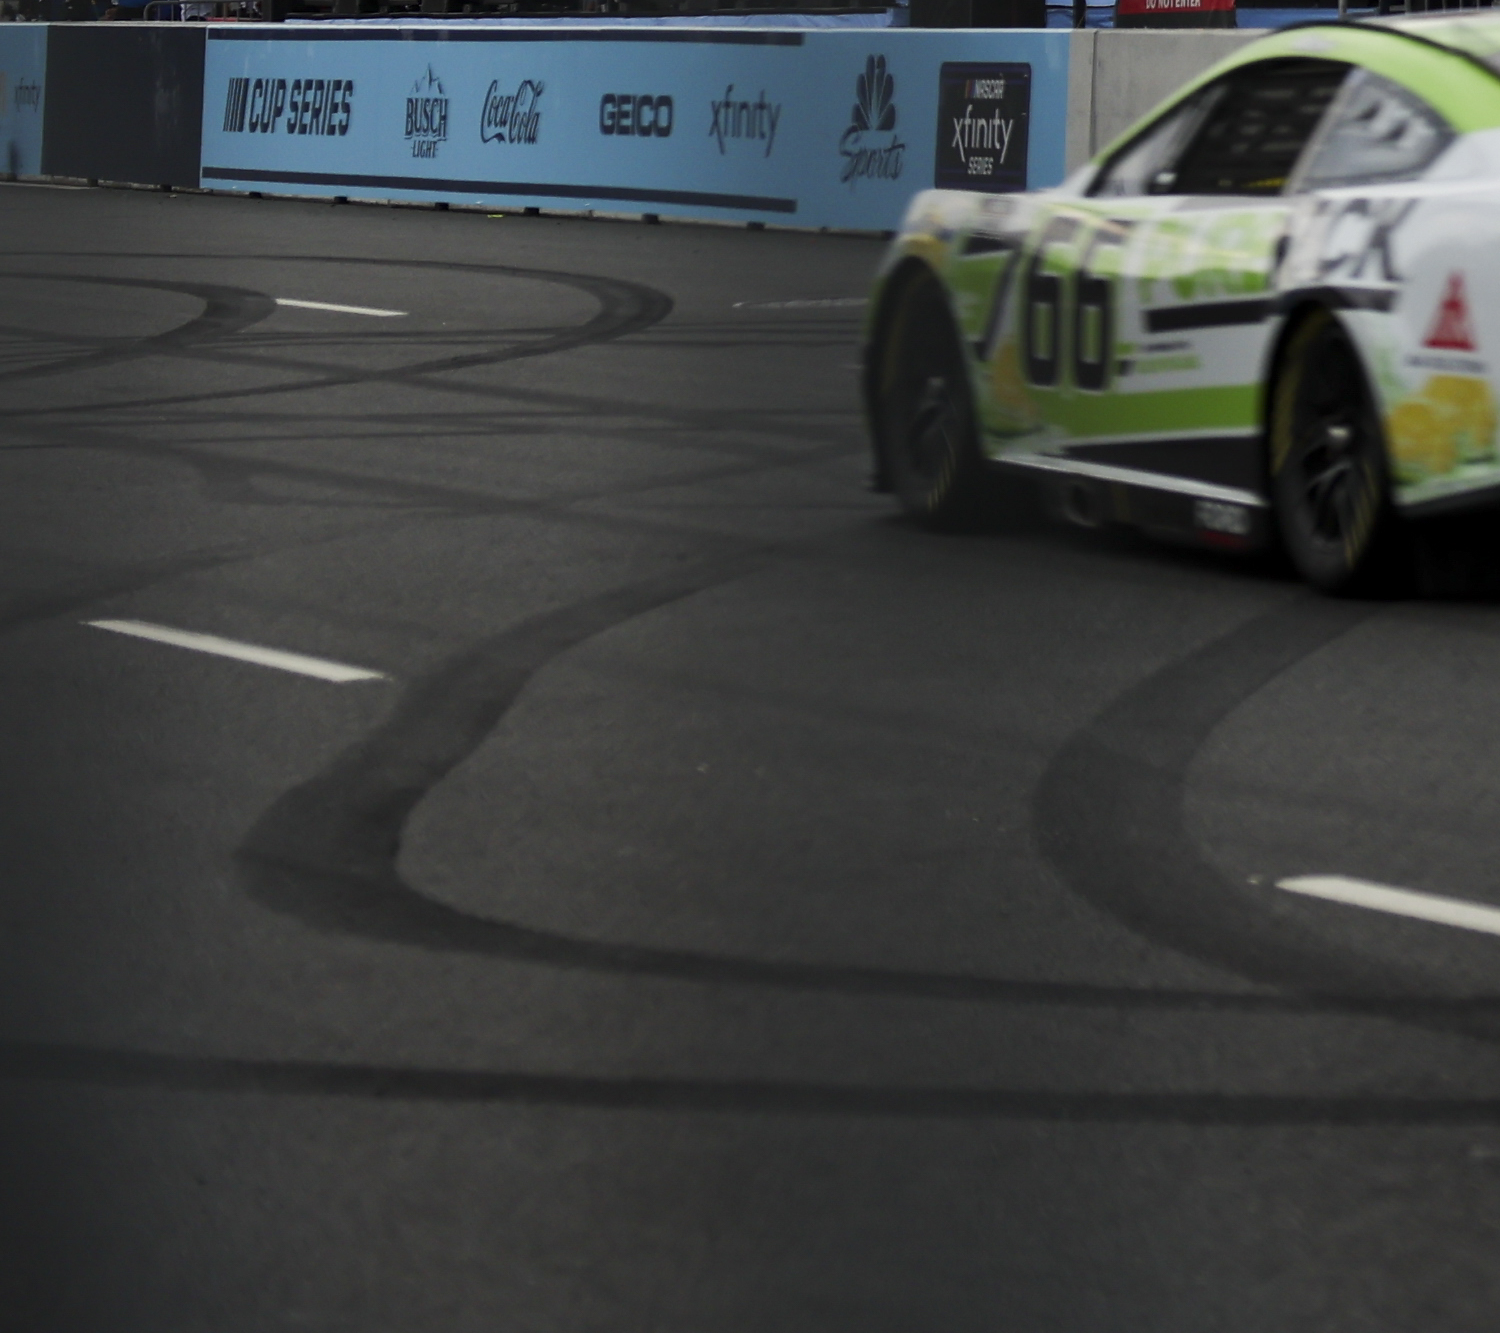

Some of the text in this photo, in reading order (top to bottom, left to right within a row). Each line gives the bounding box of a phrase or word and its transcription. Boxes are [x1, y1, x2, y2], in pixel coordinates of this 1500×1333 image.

[249, 78, 354, 136] CUP SERIES
[973, 79, 1006, 99] NASCAR
[404, 97, 449, 138] BUSCH
[600, 93, 675, 138] GEICO
[708, 84, 782, 158] xfinity
[951, 104, 1014, 164] xfinity
[411, 140, 438, 158] LIGHT
[839, 123, 906, 183] Sports
[967, 156, 995, 175] SERIES
